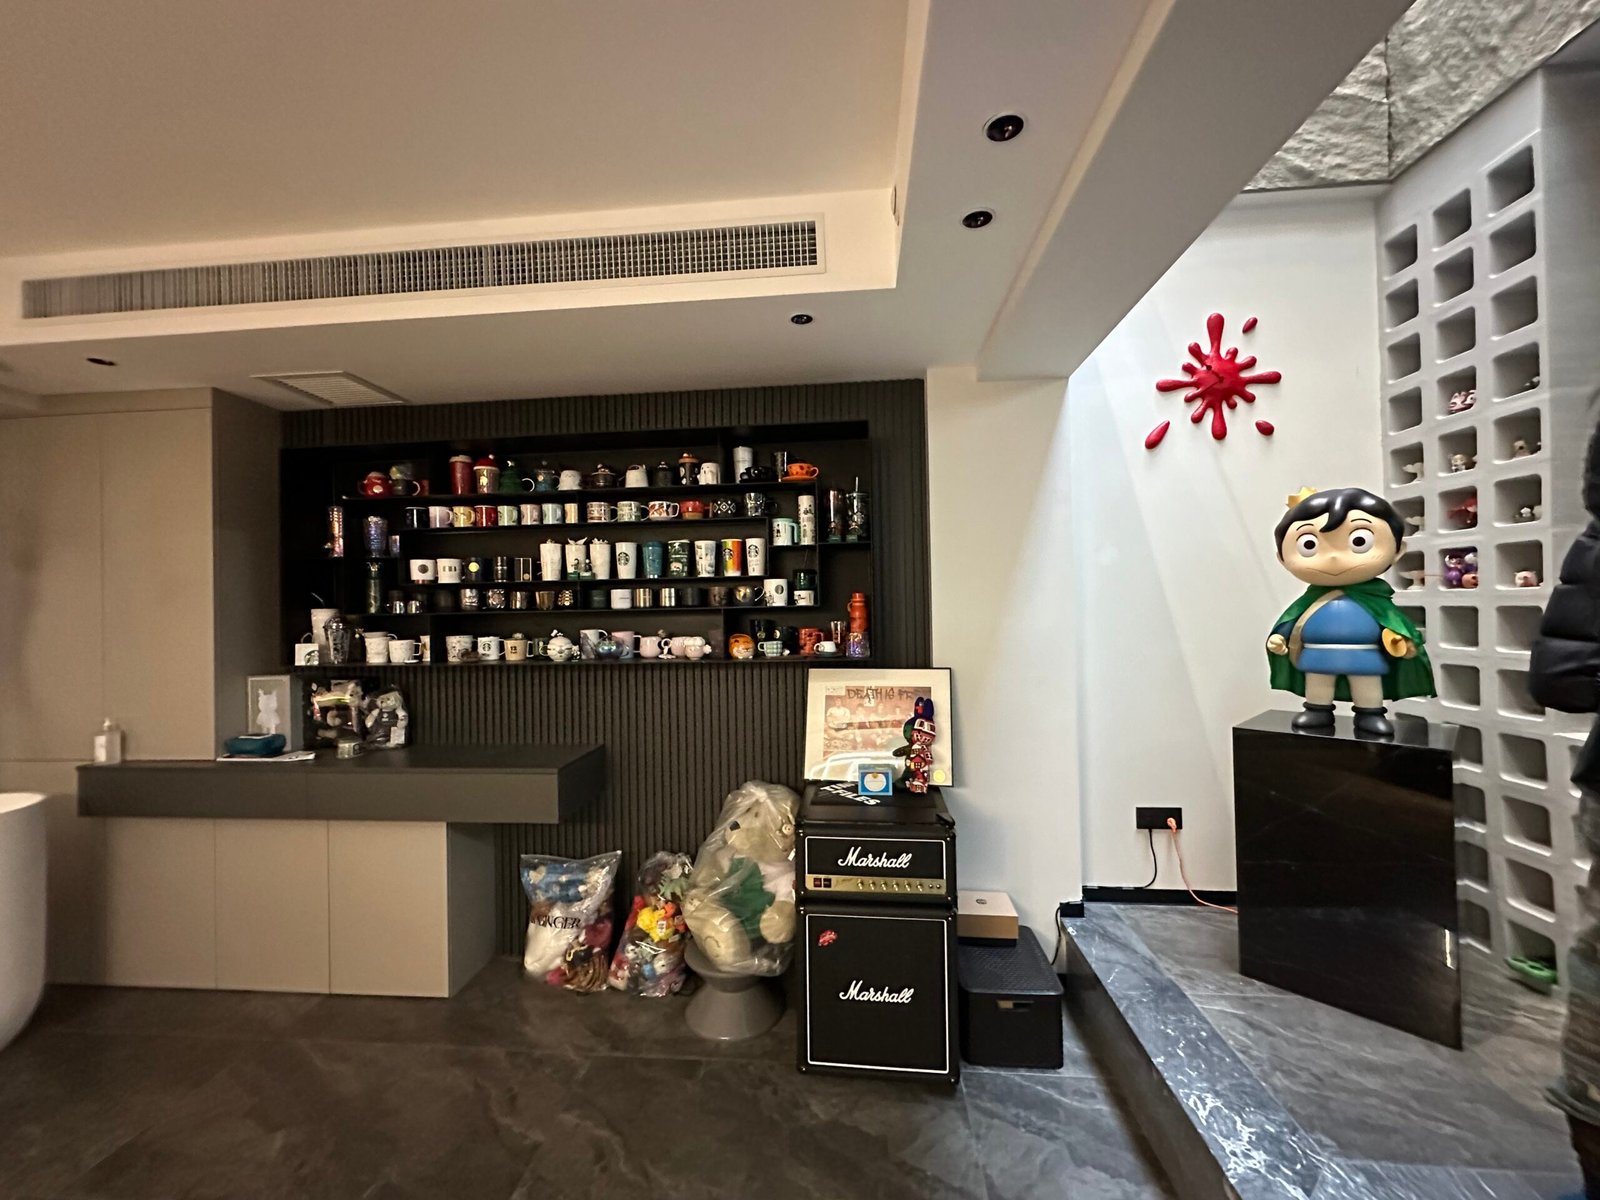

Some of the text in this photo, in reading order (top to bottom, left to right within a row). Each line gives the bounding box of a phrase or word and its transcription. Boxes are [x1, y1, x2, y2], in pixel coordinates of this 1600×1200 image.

[846, 687, 882, 700] DEATH
[838, 847, 912, 868] Marshall
[839, 980, 914, 1003] Marshall
